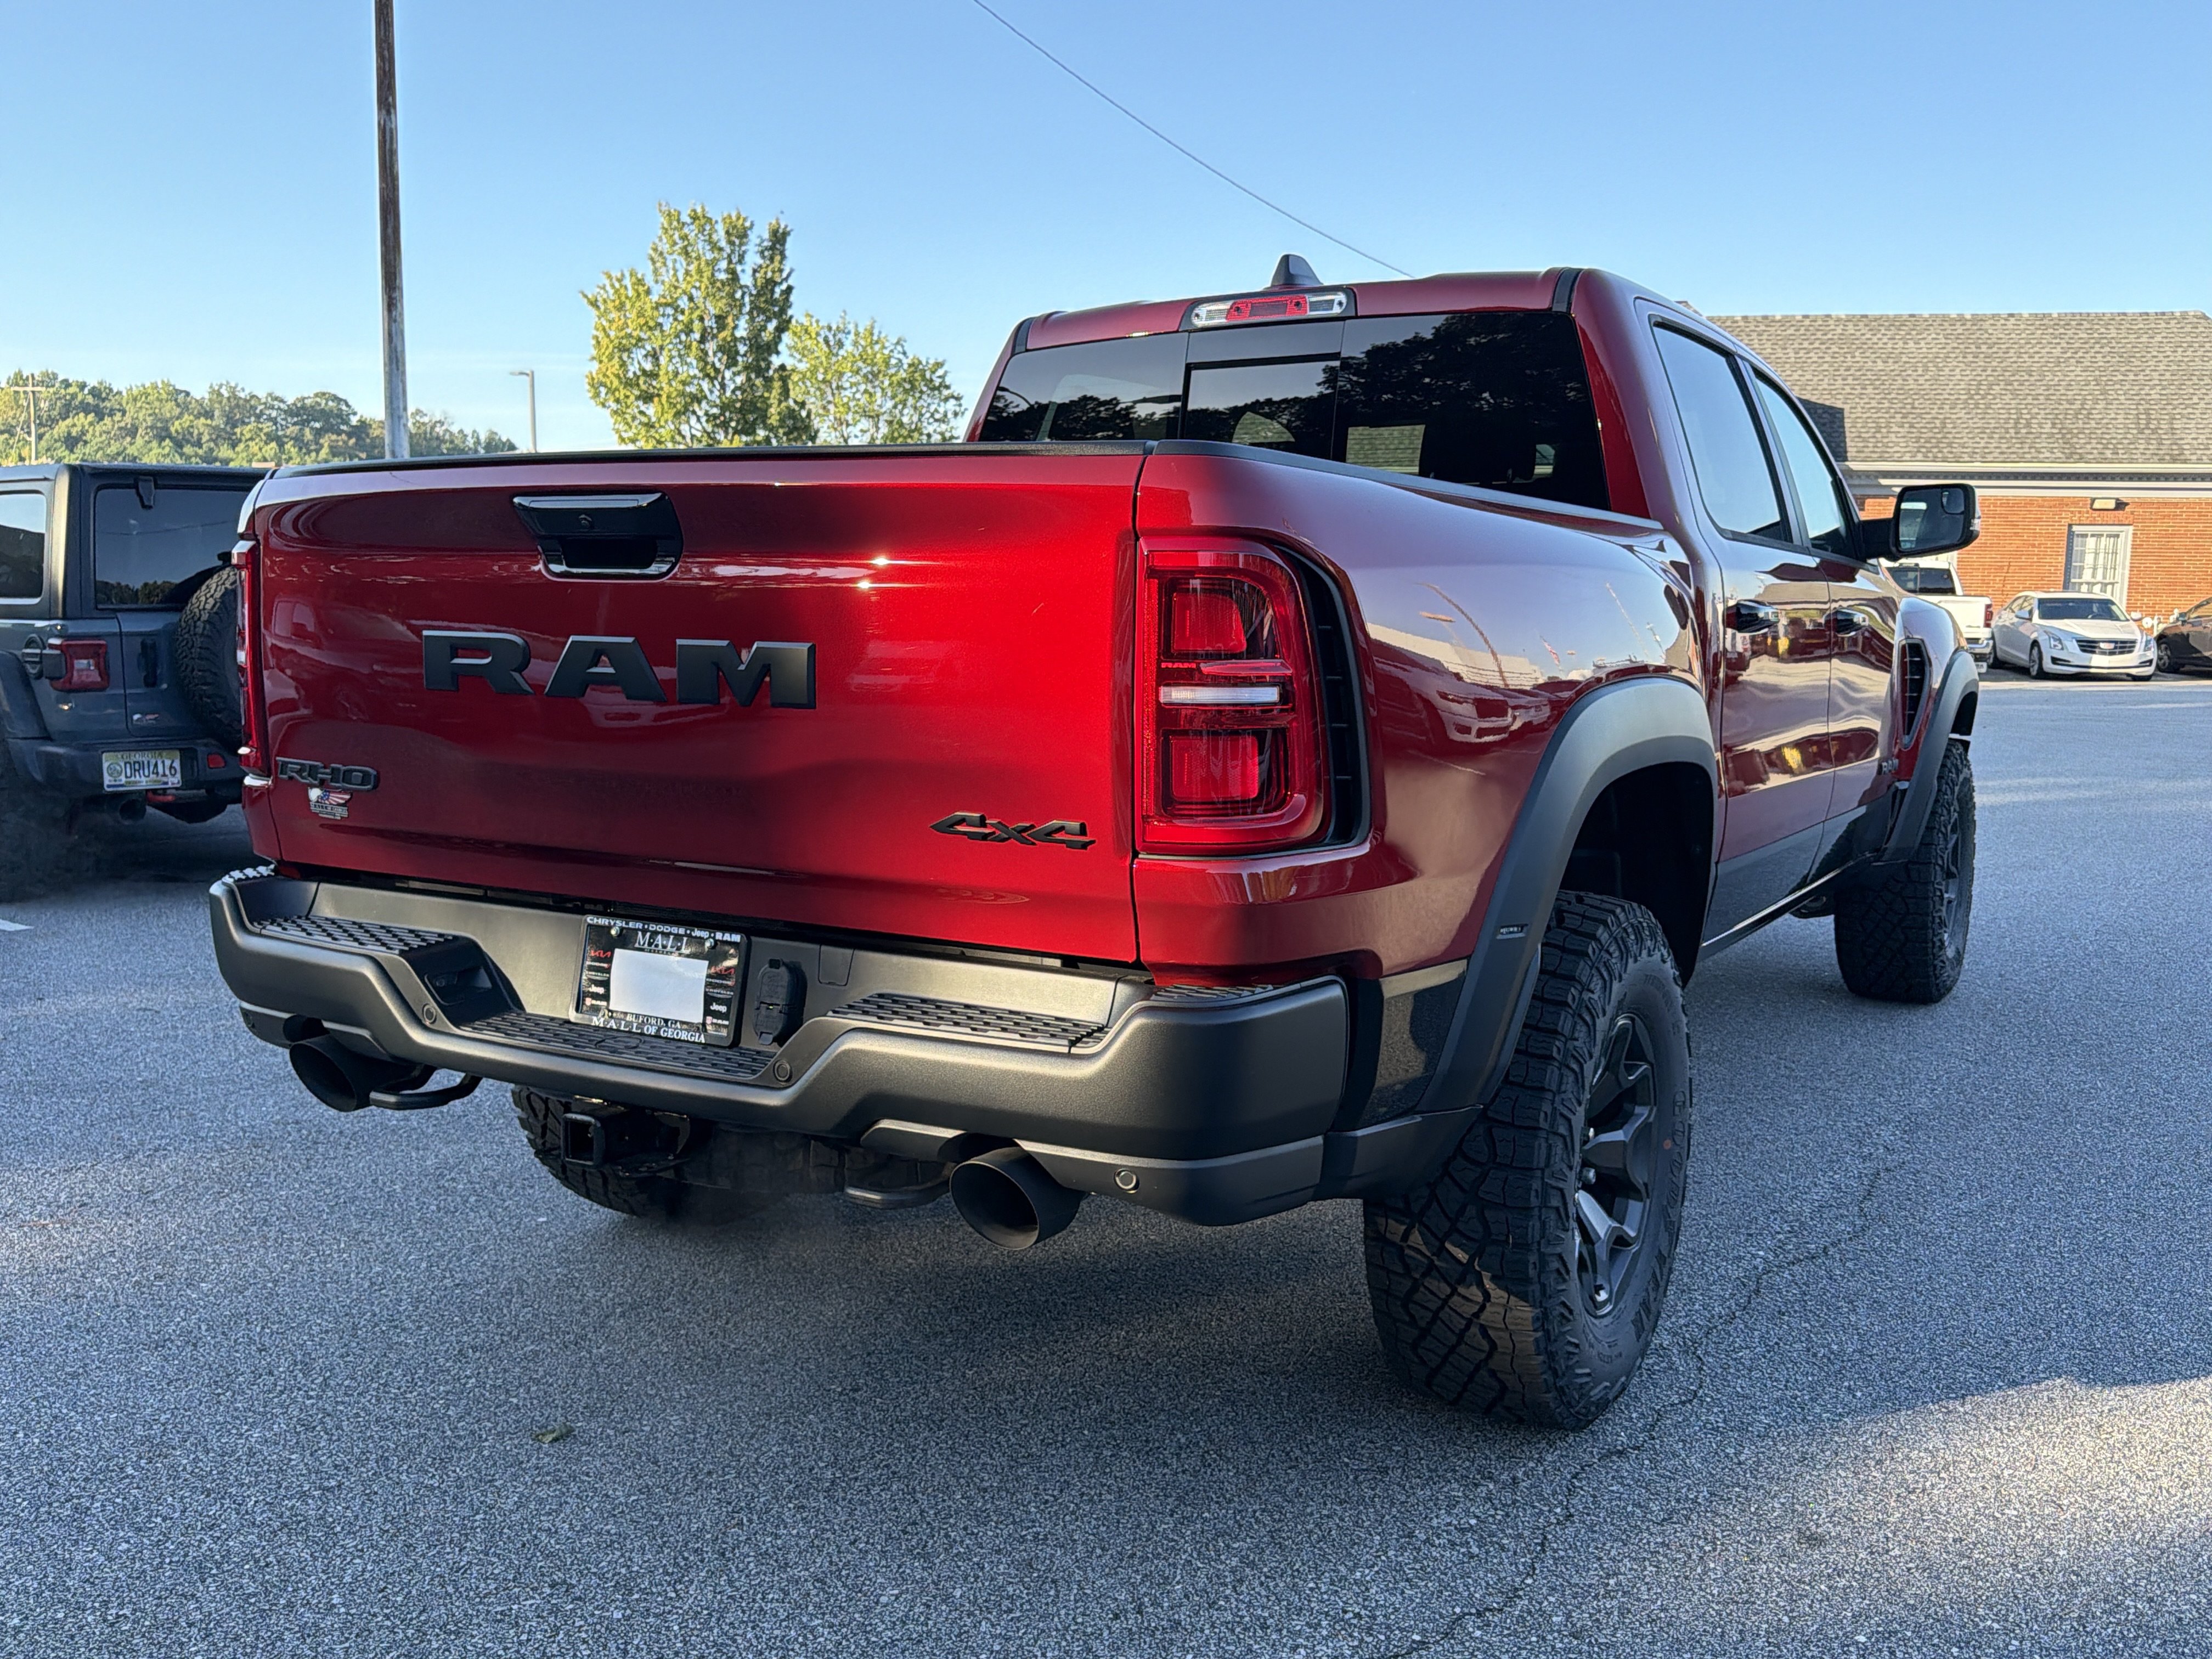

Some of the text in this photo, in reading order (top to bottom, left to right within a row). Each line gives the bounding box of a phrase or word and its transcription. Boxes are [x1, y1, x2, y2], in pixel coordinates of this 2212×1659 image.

[422, 630, 816, 709] RAM
[121, 751, 163, 760] GEORGIA
[124, 760, 177, 779] DRU416
[275, 757, 379, 790] RHO
[586, 916, 741, 943] CHRYSLER DODGE Jeep RAM
[710, 1002, 727, 1013] Jeep
[644, 1024, 658, 1035] OF
[660, 1027, 706, 1043] GEORGIA
[668, 1019, 681, 1029] GA
